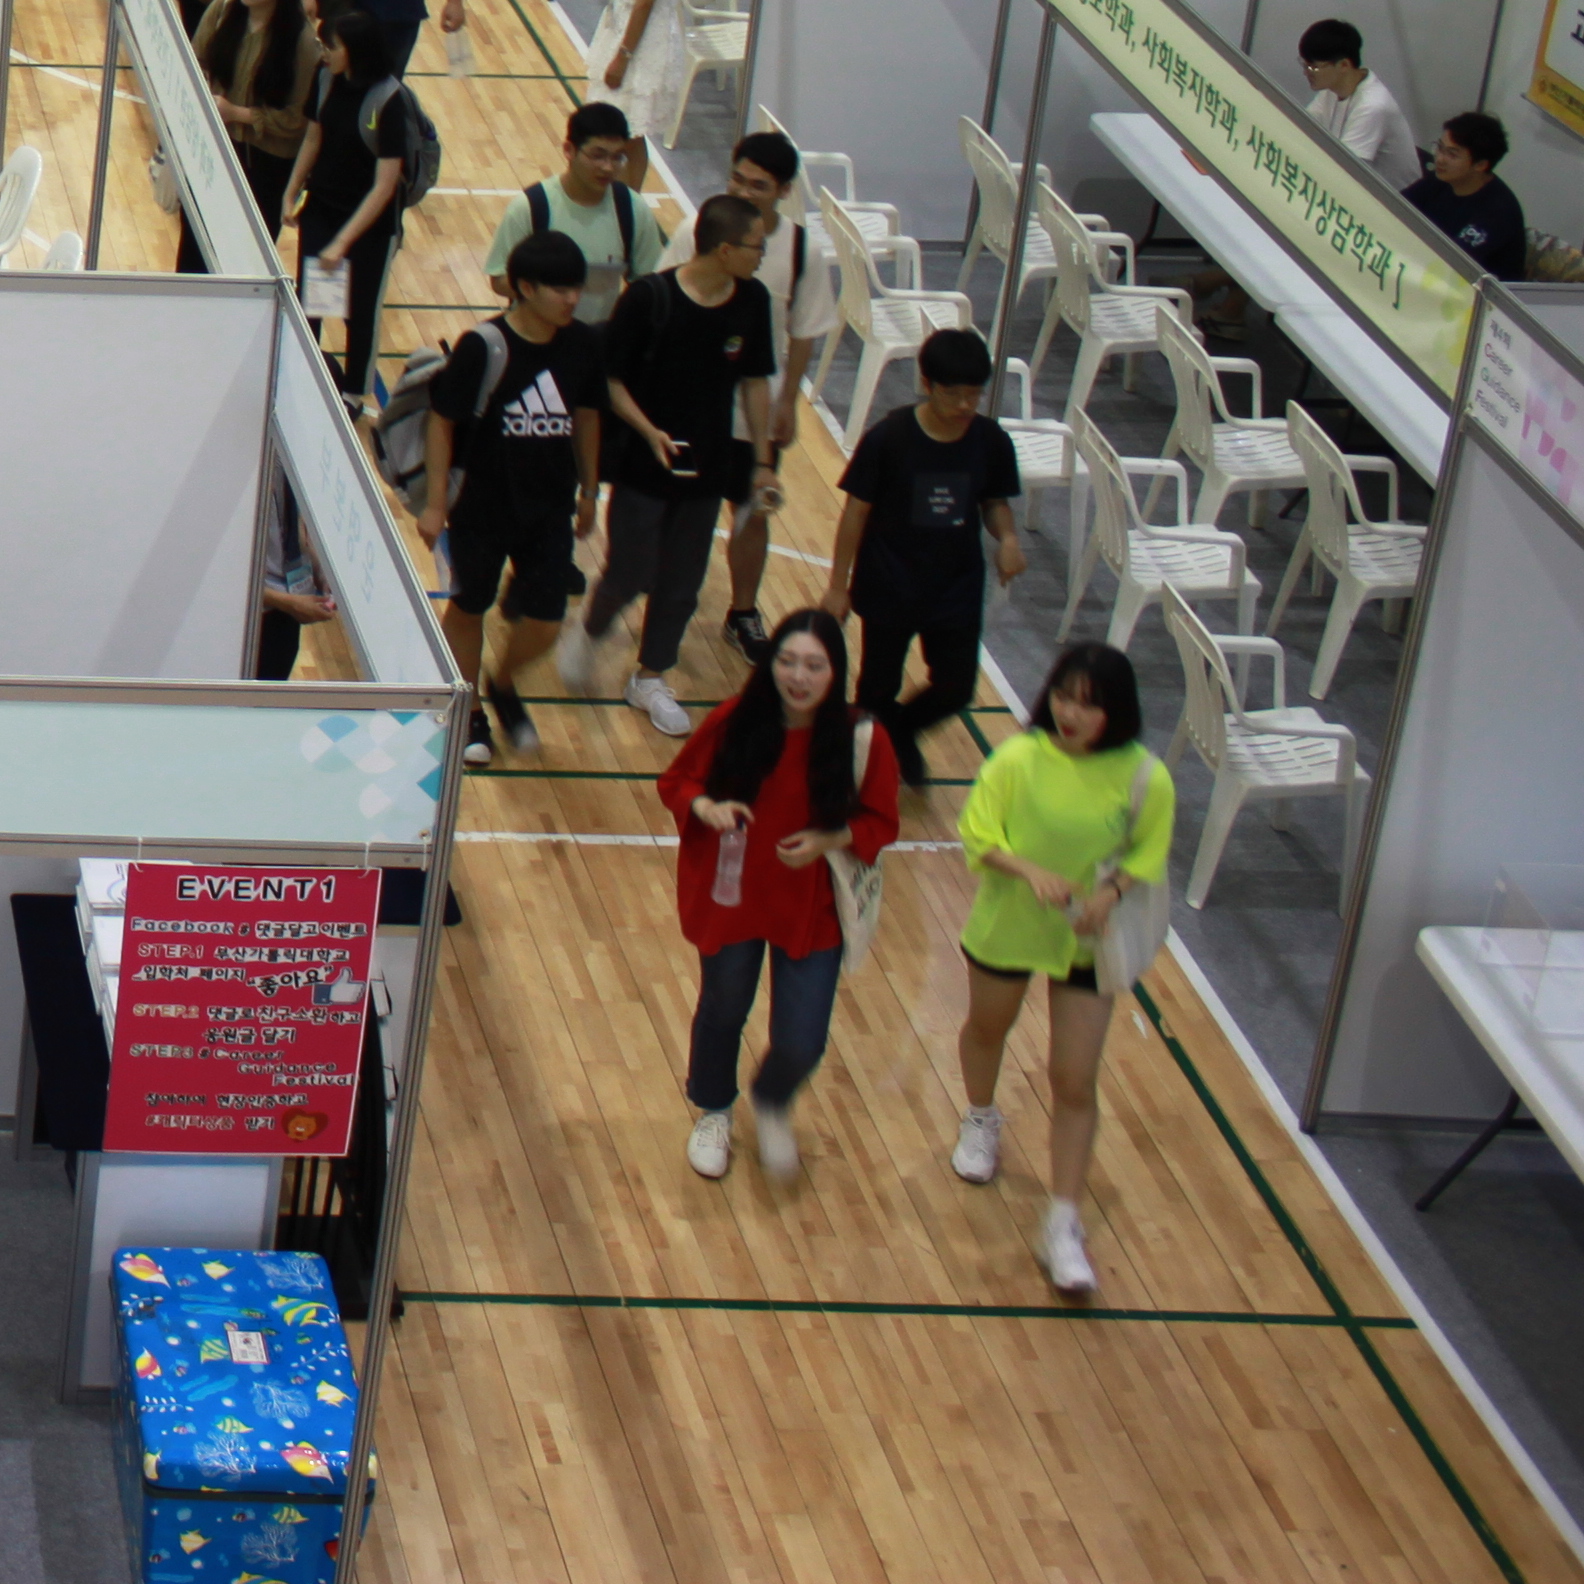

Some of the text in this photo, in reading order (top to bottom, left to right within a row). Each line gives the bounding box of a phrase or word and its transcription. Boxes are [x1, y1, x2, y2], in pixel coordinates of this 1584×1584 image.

[1142, 27, 1238, 152] 사회복지학과,
[1485, 342, 1513, 377] Career
[1481, 367, 1521, 413] Guidance
[178, 875, 335, 902] EVENT1
[131, 918, 233, 934] Facebook
[138, 944, 349, 962] STEP.1 부산가톨릭대학교
[144, 966, 246, 981] 입학처 페이지
[262, 1028, 296, 1044] 달기
[238, 1062, 336, 1074] Guidance
[273, 1075, 355, 1086] Festival
